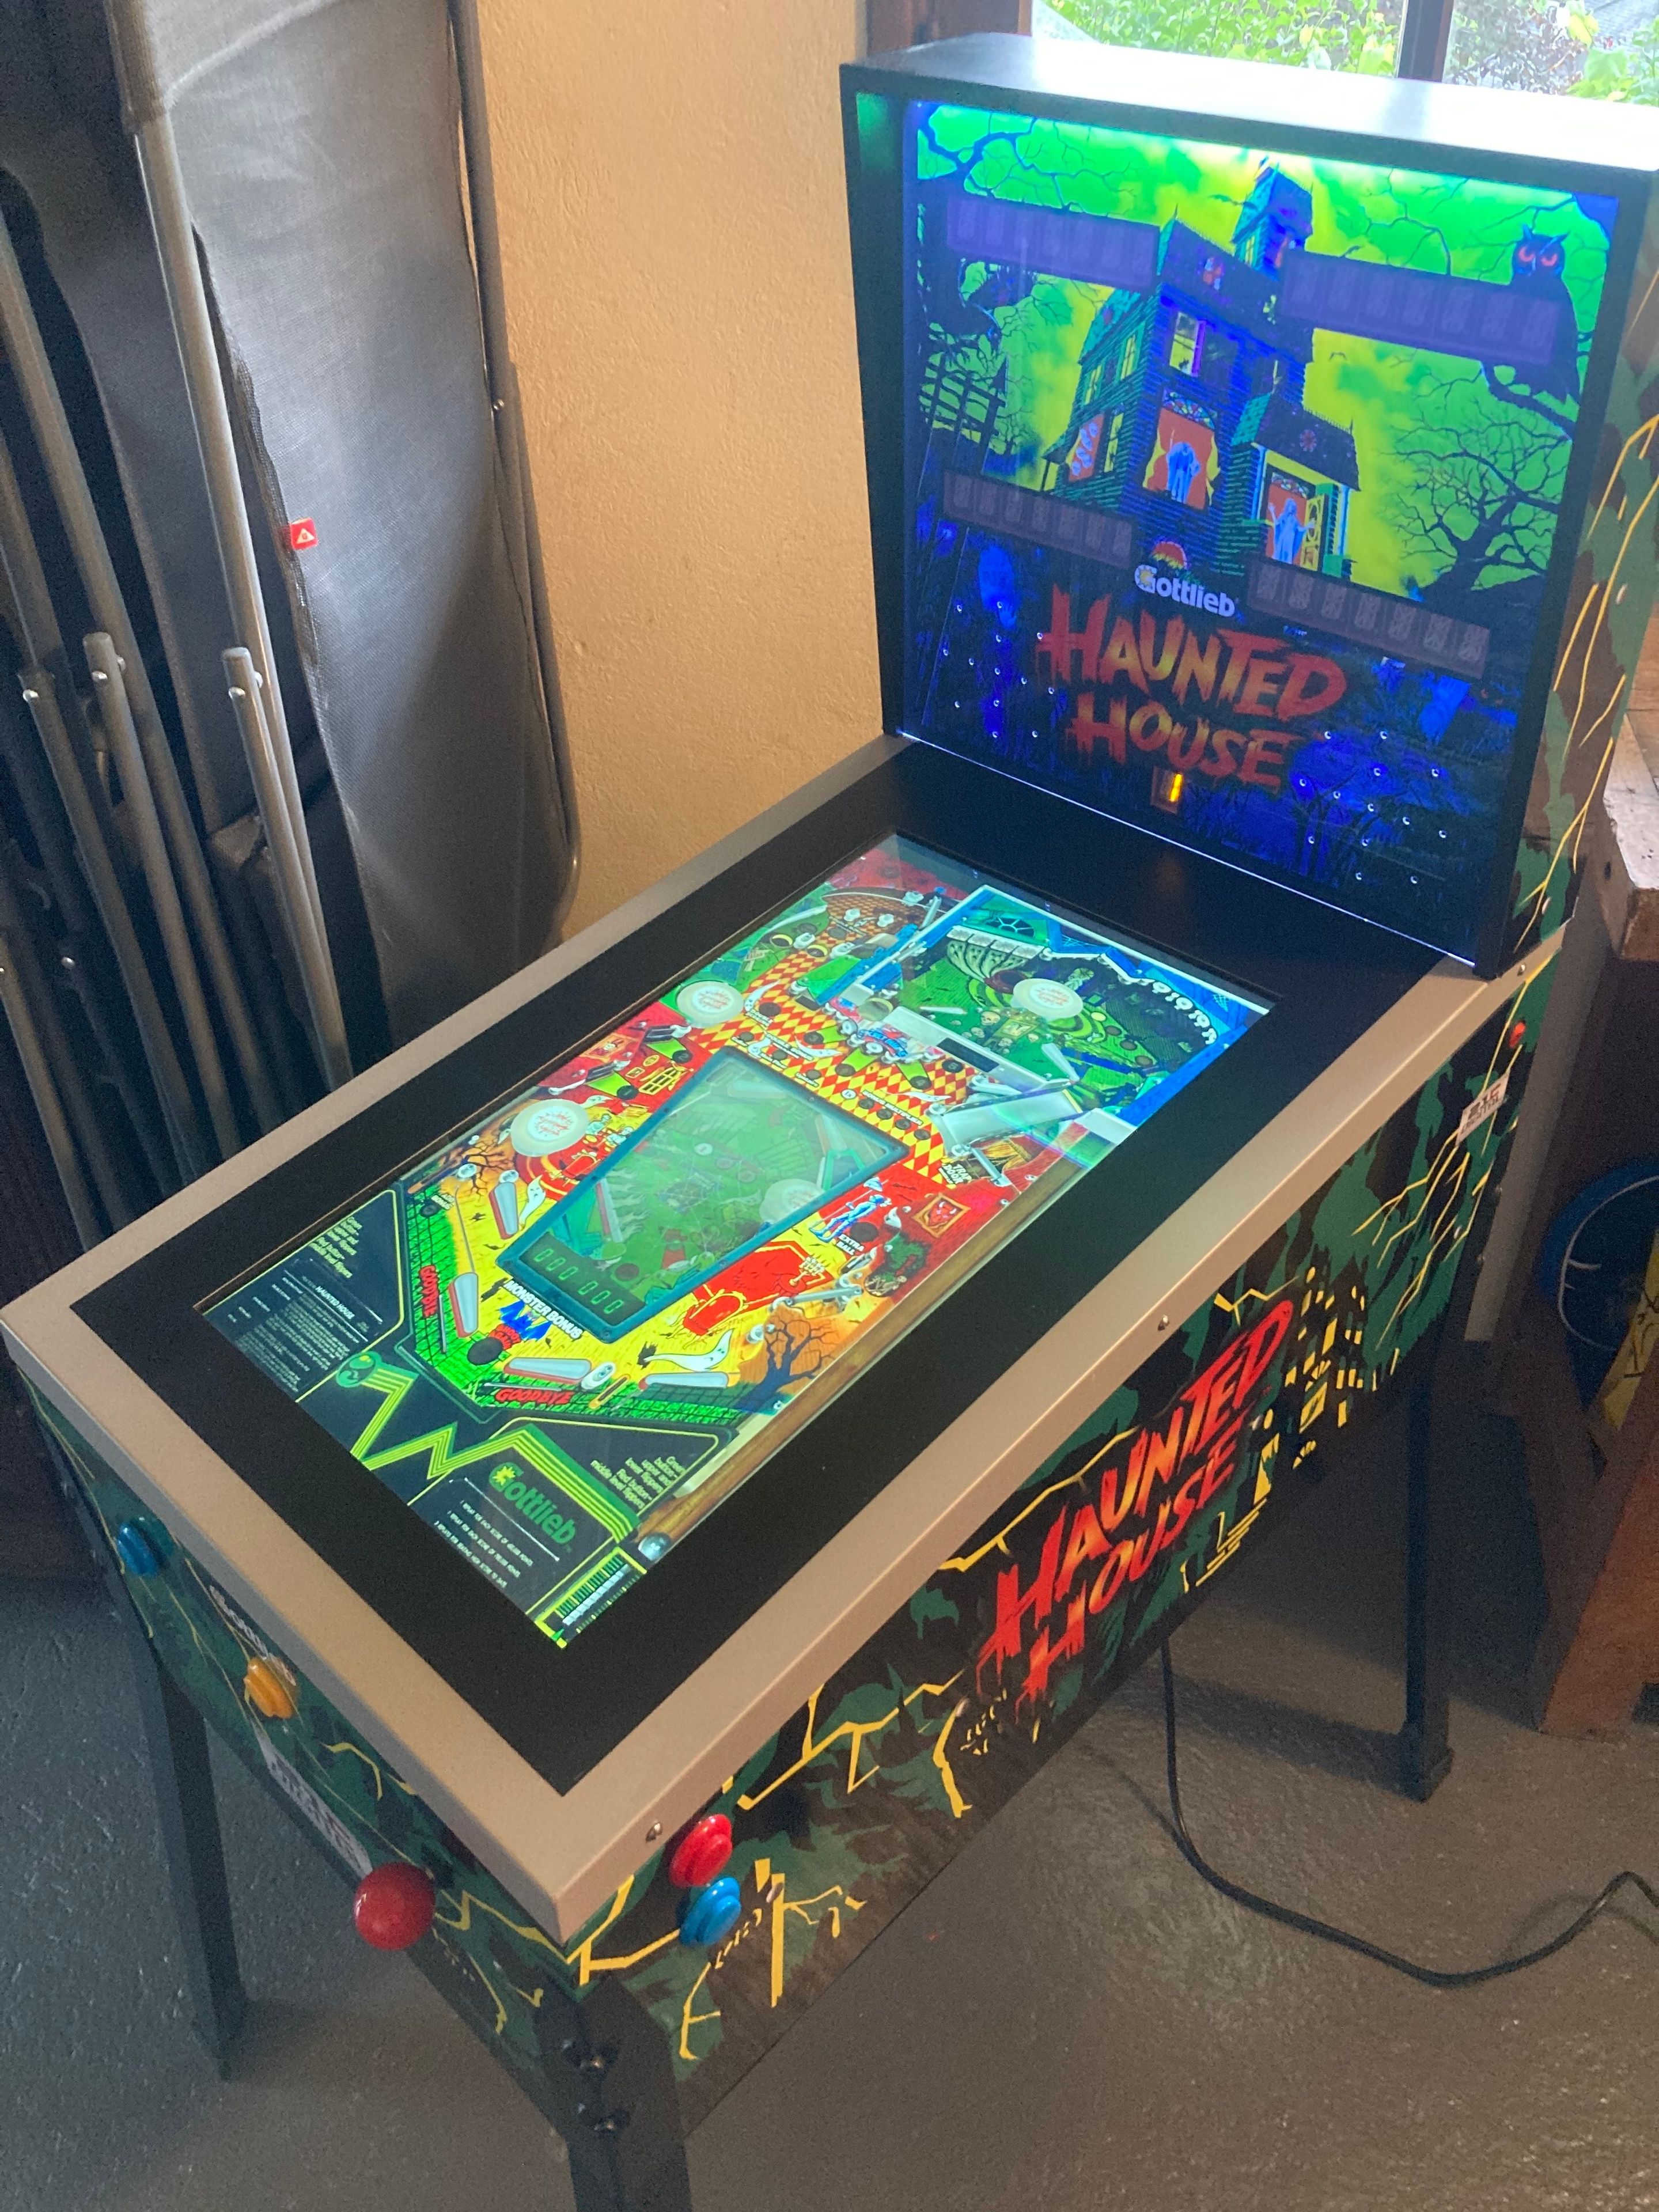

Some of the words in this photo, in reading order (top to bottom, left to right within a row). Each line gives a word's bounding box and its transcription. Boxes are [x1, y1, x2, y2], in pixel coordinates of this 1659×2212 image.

[489, 310, 575, 392] Gottlieb
[1134, 565, 1236, 617] Gottlieb
[1035, 585, 1347, 722] HAUNTED
[1066, 692, 1304, 793] HOUSE
[836, 1241, 855, 1255] BALL
[838, 1233, 864, 1252] EXTRA
[315, 1285, 340, 1306] HAUNTED
[336, 1303, 355, 1320] HOUSE
[502, 1281, 552, 1316] MONSTER
[546, 1310, 584, 1339] BONUS
[496, 1387, 575, 1405] GOODBYE
[976, 1301, 1294, 1692] HAUNTED
[1016, 1407, 1249, 1720] HOUSE
